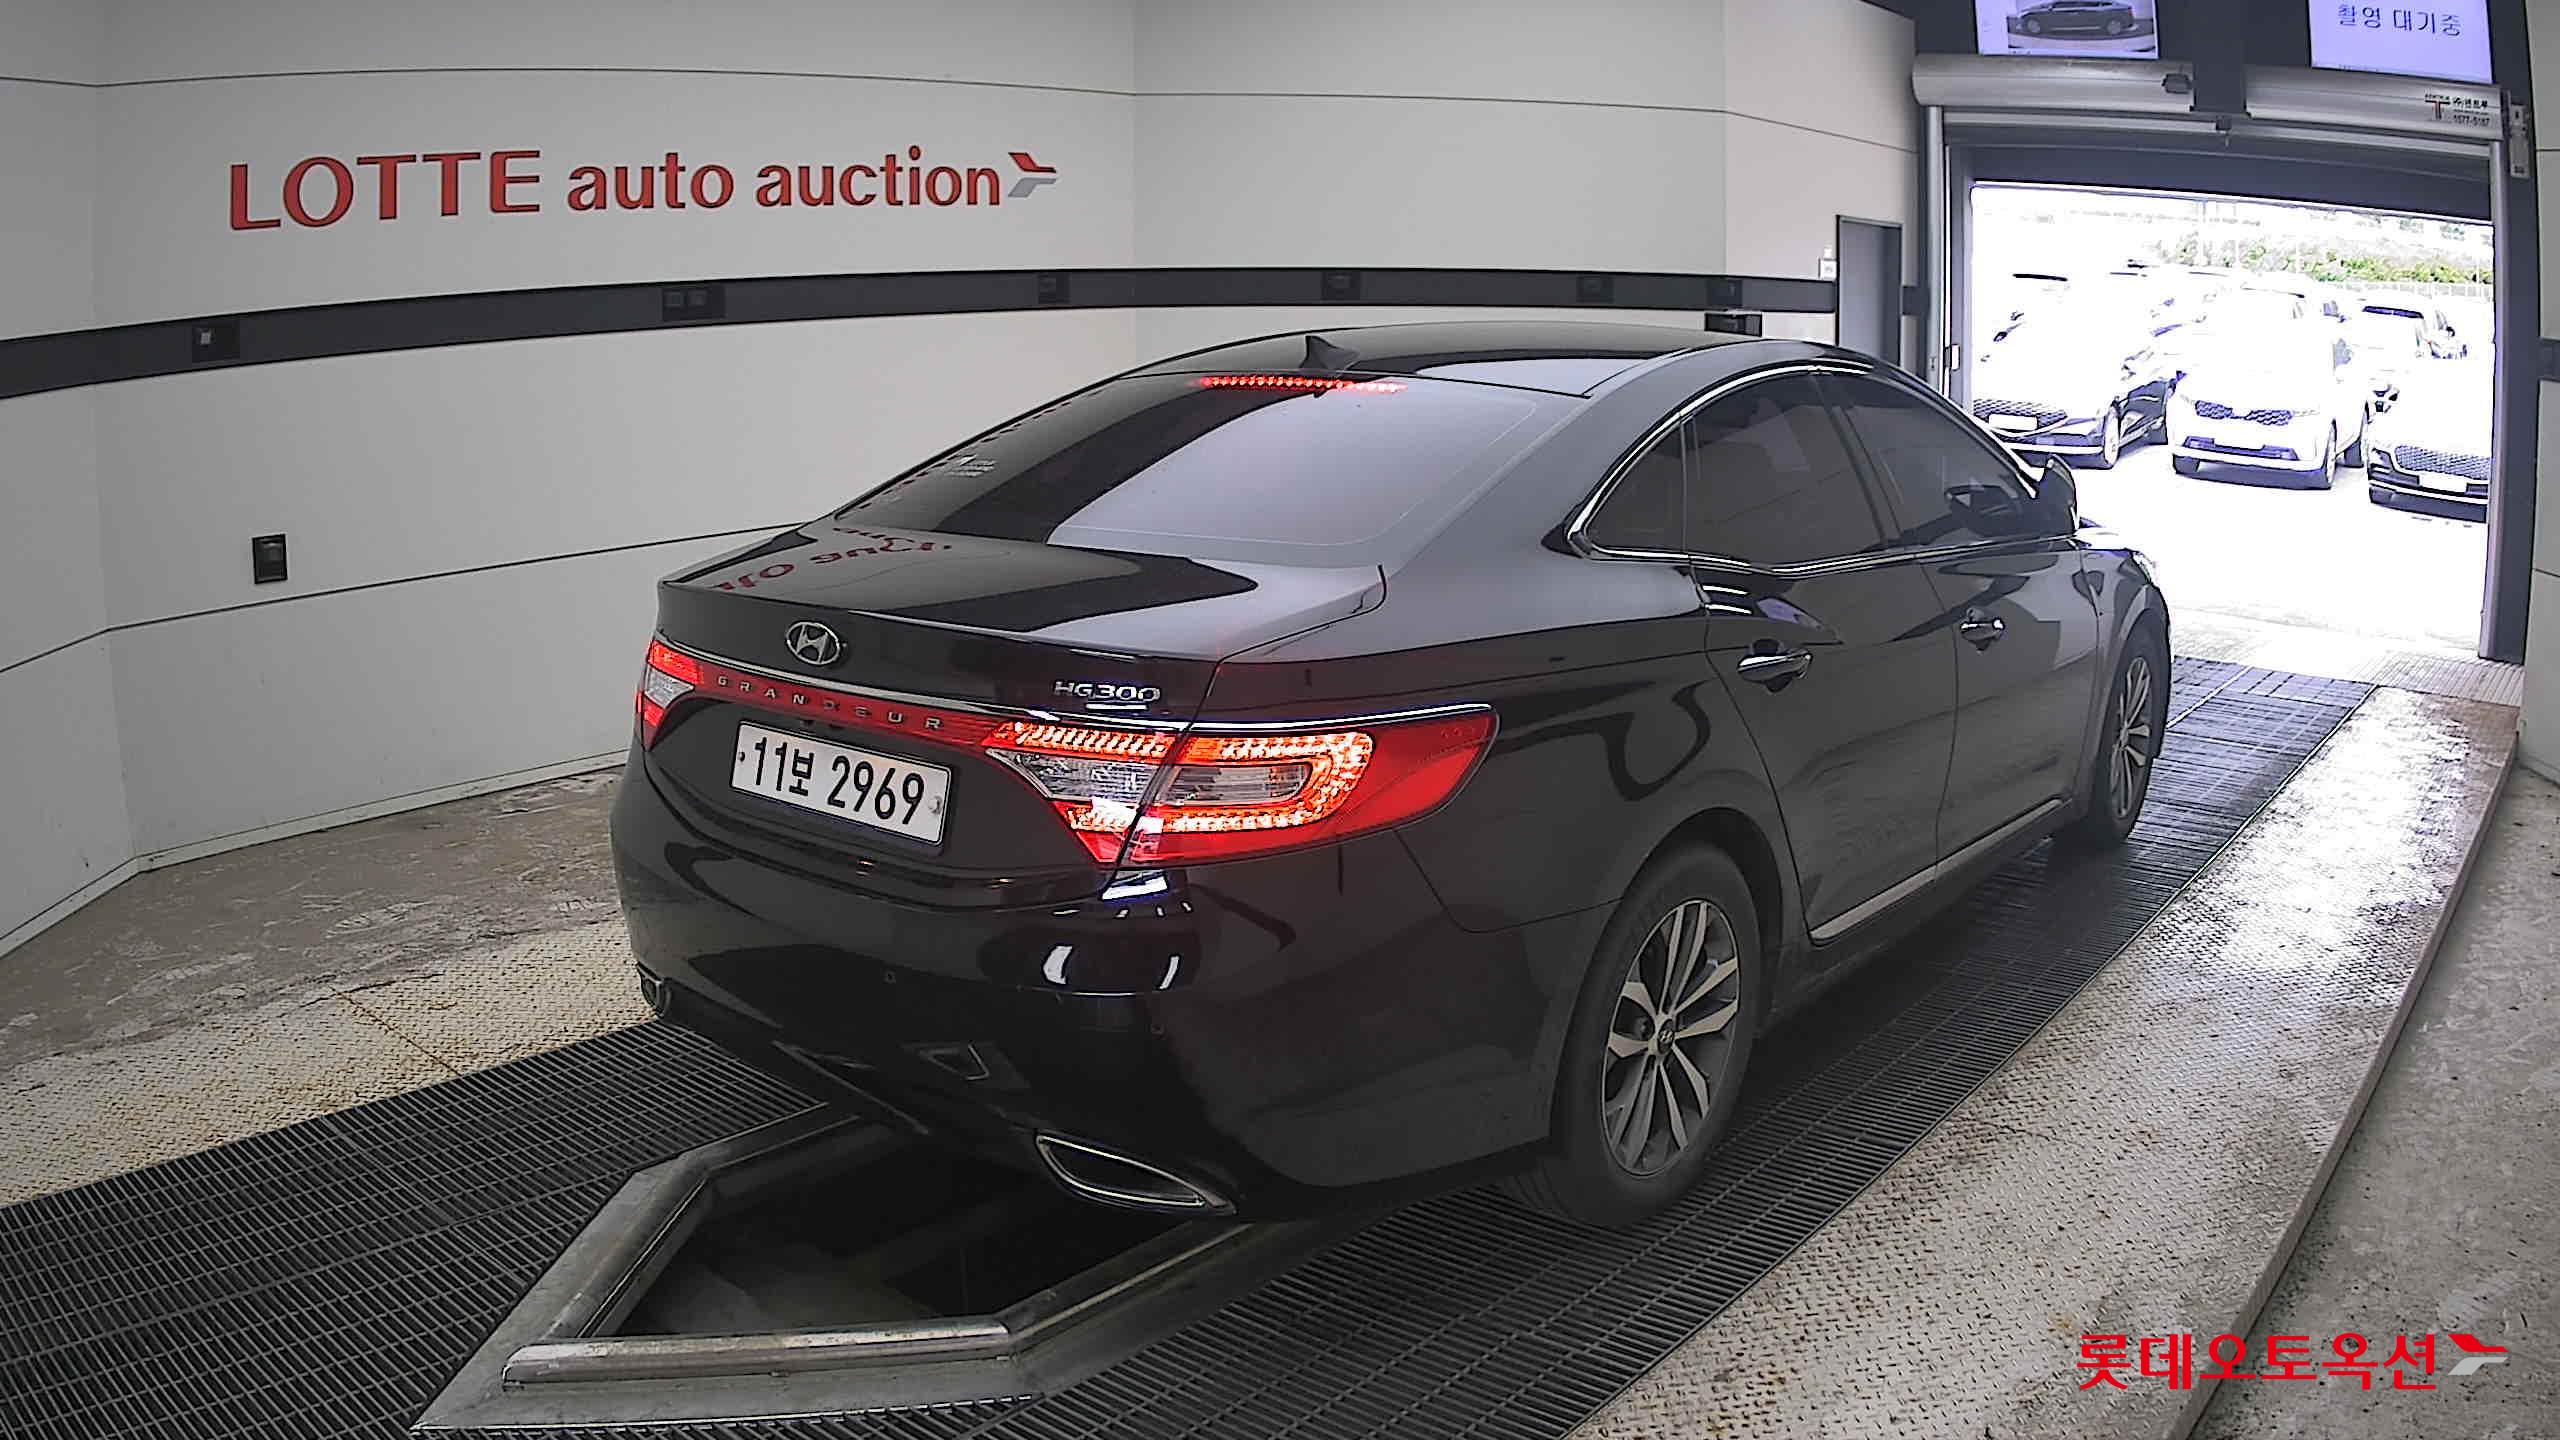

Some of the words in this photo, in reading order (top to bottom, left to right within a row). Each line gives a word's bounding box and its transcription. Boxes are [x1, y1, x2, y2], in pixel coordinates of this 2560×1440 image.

[2338, 4, 2382, 29] 촬영
[2393, 9, 2462, 37] 대기중
[230, 150, 541, 231] LOTTE
[567, 152, 735, 211] auto
[755, 145, 1001, 207] auction
[717, 675, 945, 730] GRANDEUR
[1054, 681, 1161, 702] HG300
[754, 736, 815, 797] 11보
[826, 755, 925, 825] 2969
